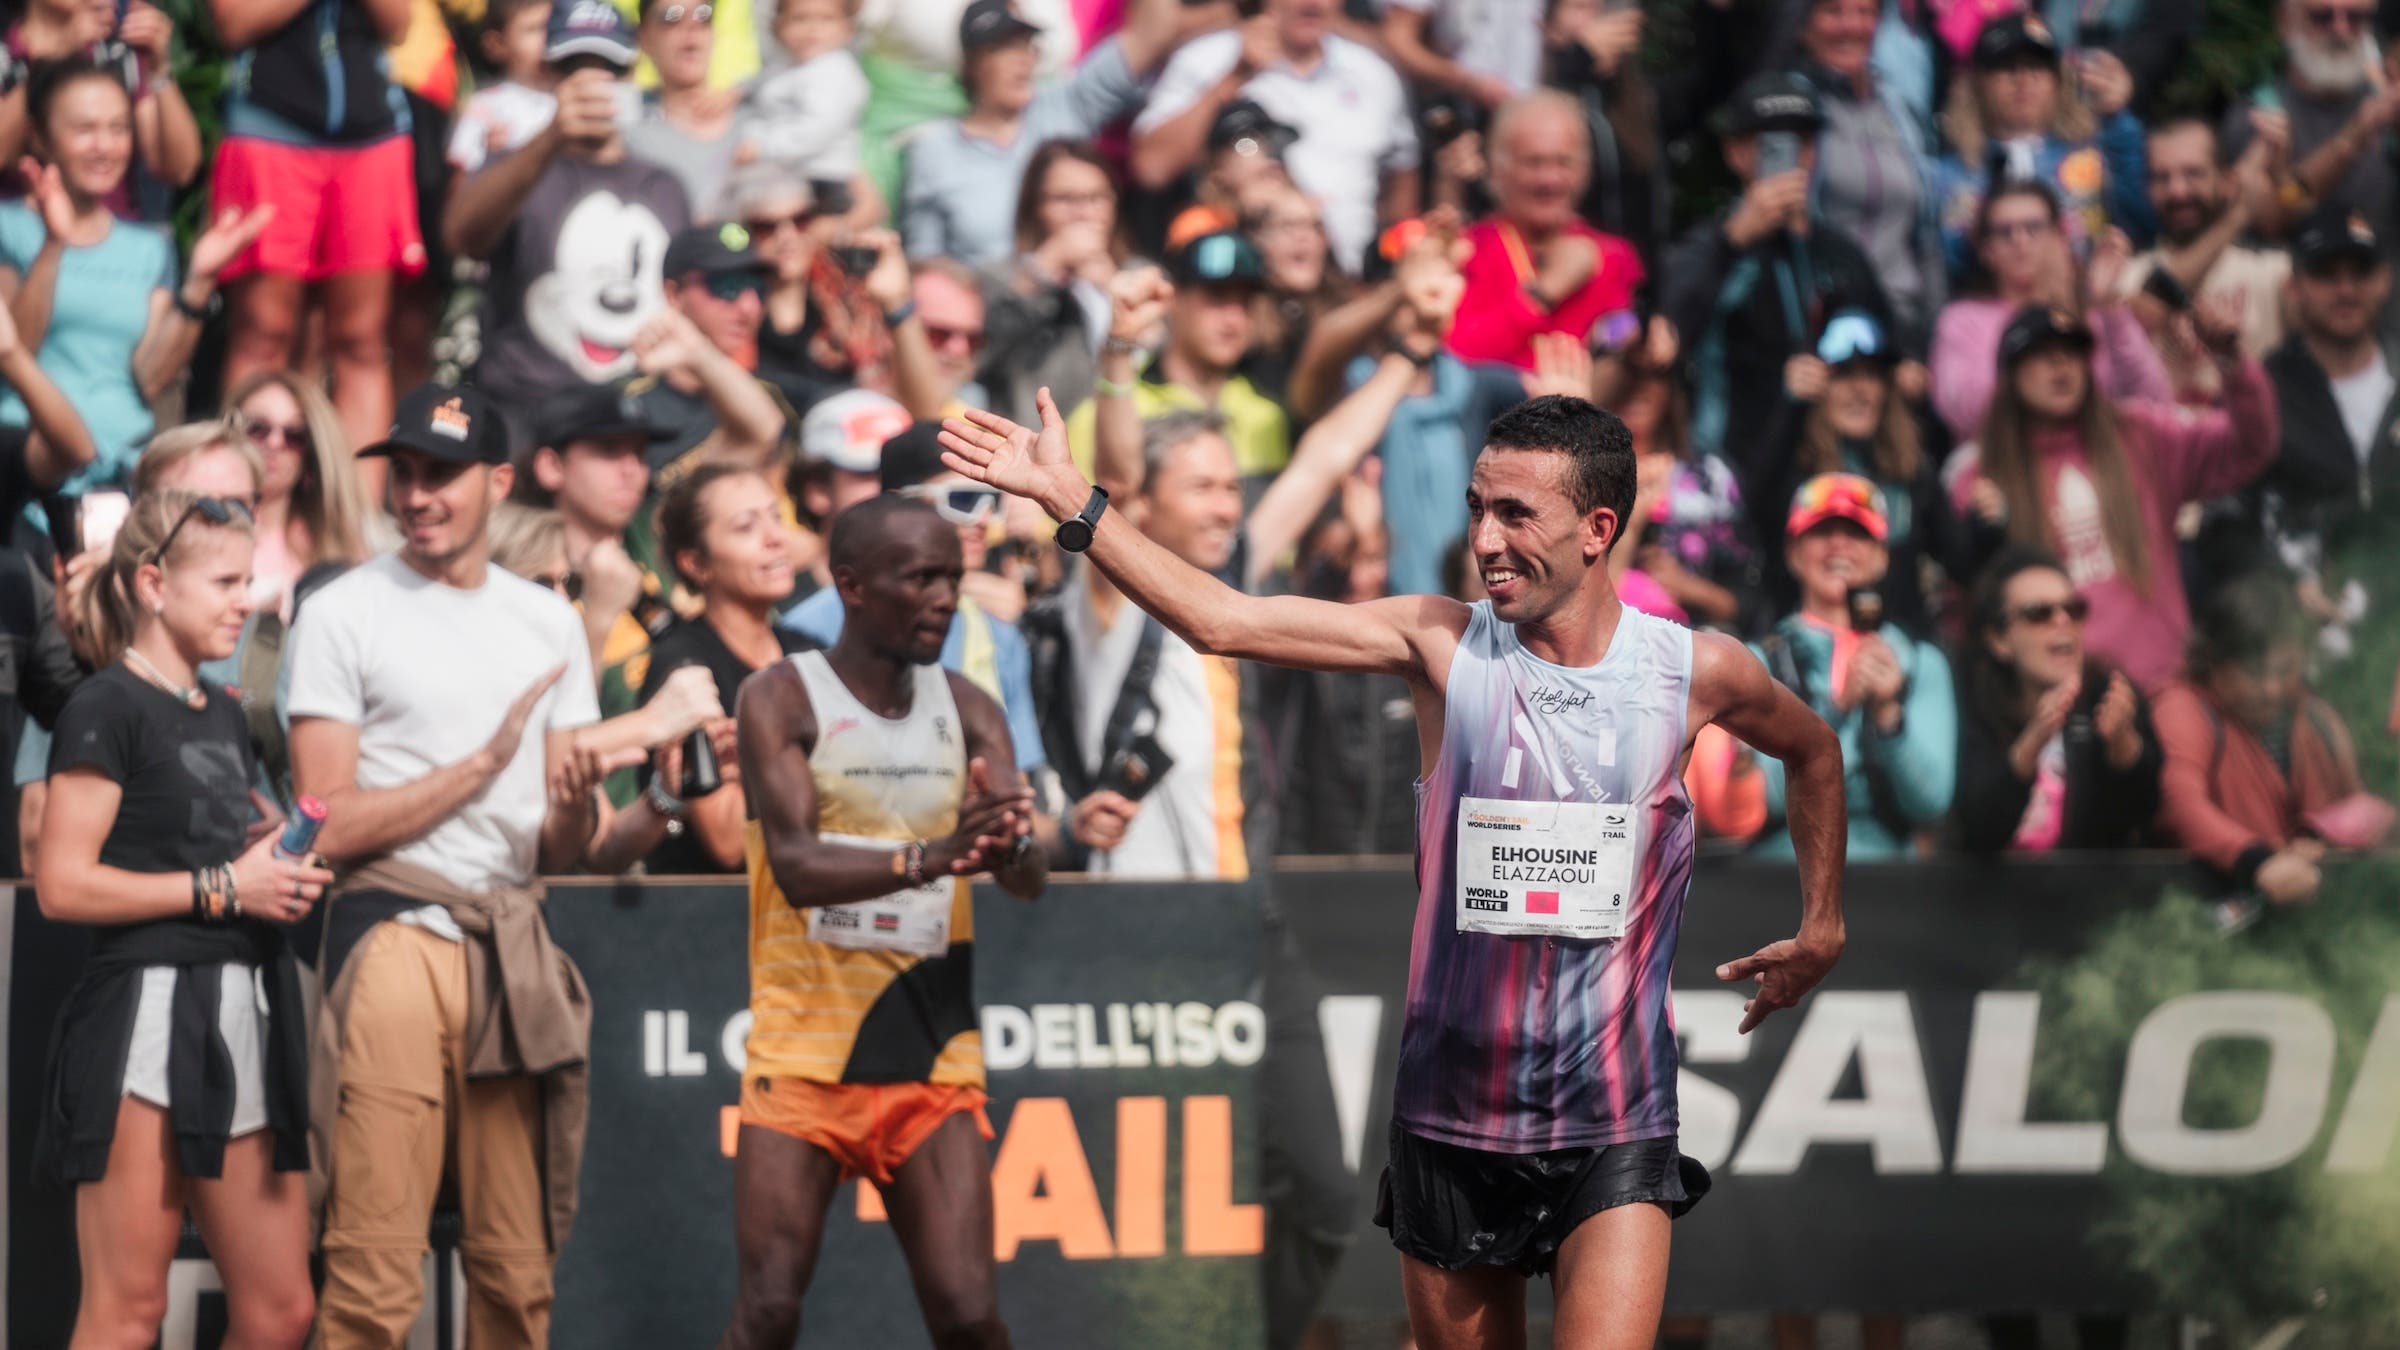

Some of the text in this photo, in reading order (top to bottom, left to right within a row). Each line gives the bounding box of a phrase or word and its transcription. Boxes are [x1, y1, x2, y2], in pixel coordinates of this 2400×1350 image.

[1559, 744, 1611, 803] ormal
[1602, 831, 1627, 839] TRAIL
[1492, 846, 1597, 865] ELHOUSINE
[1492, 865, 1595, 883] ELAZZAOUI
[1465, 886, 1508, 899] WORLD
[1612, 893, 1620, 907] 8
[1470, 899, 1502, 911] ELITE
[644, 1010, 707, 1076] IL
